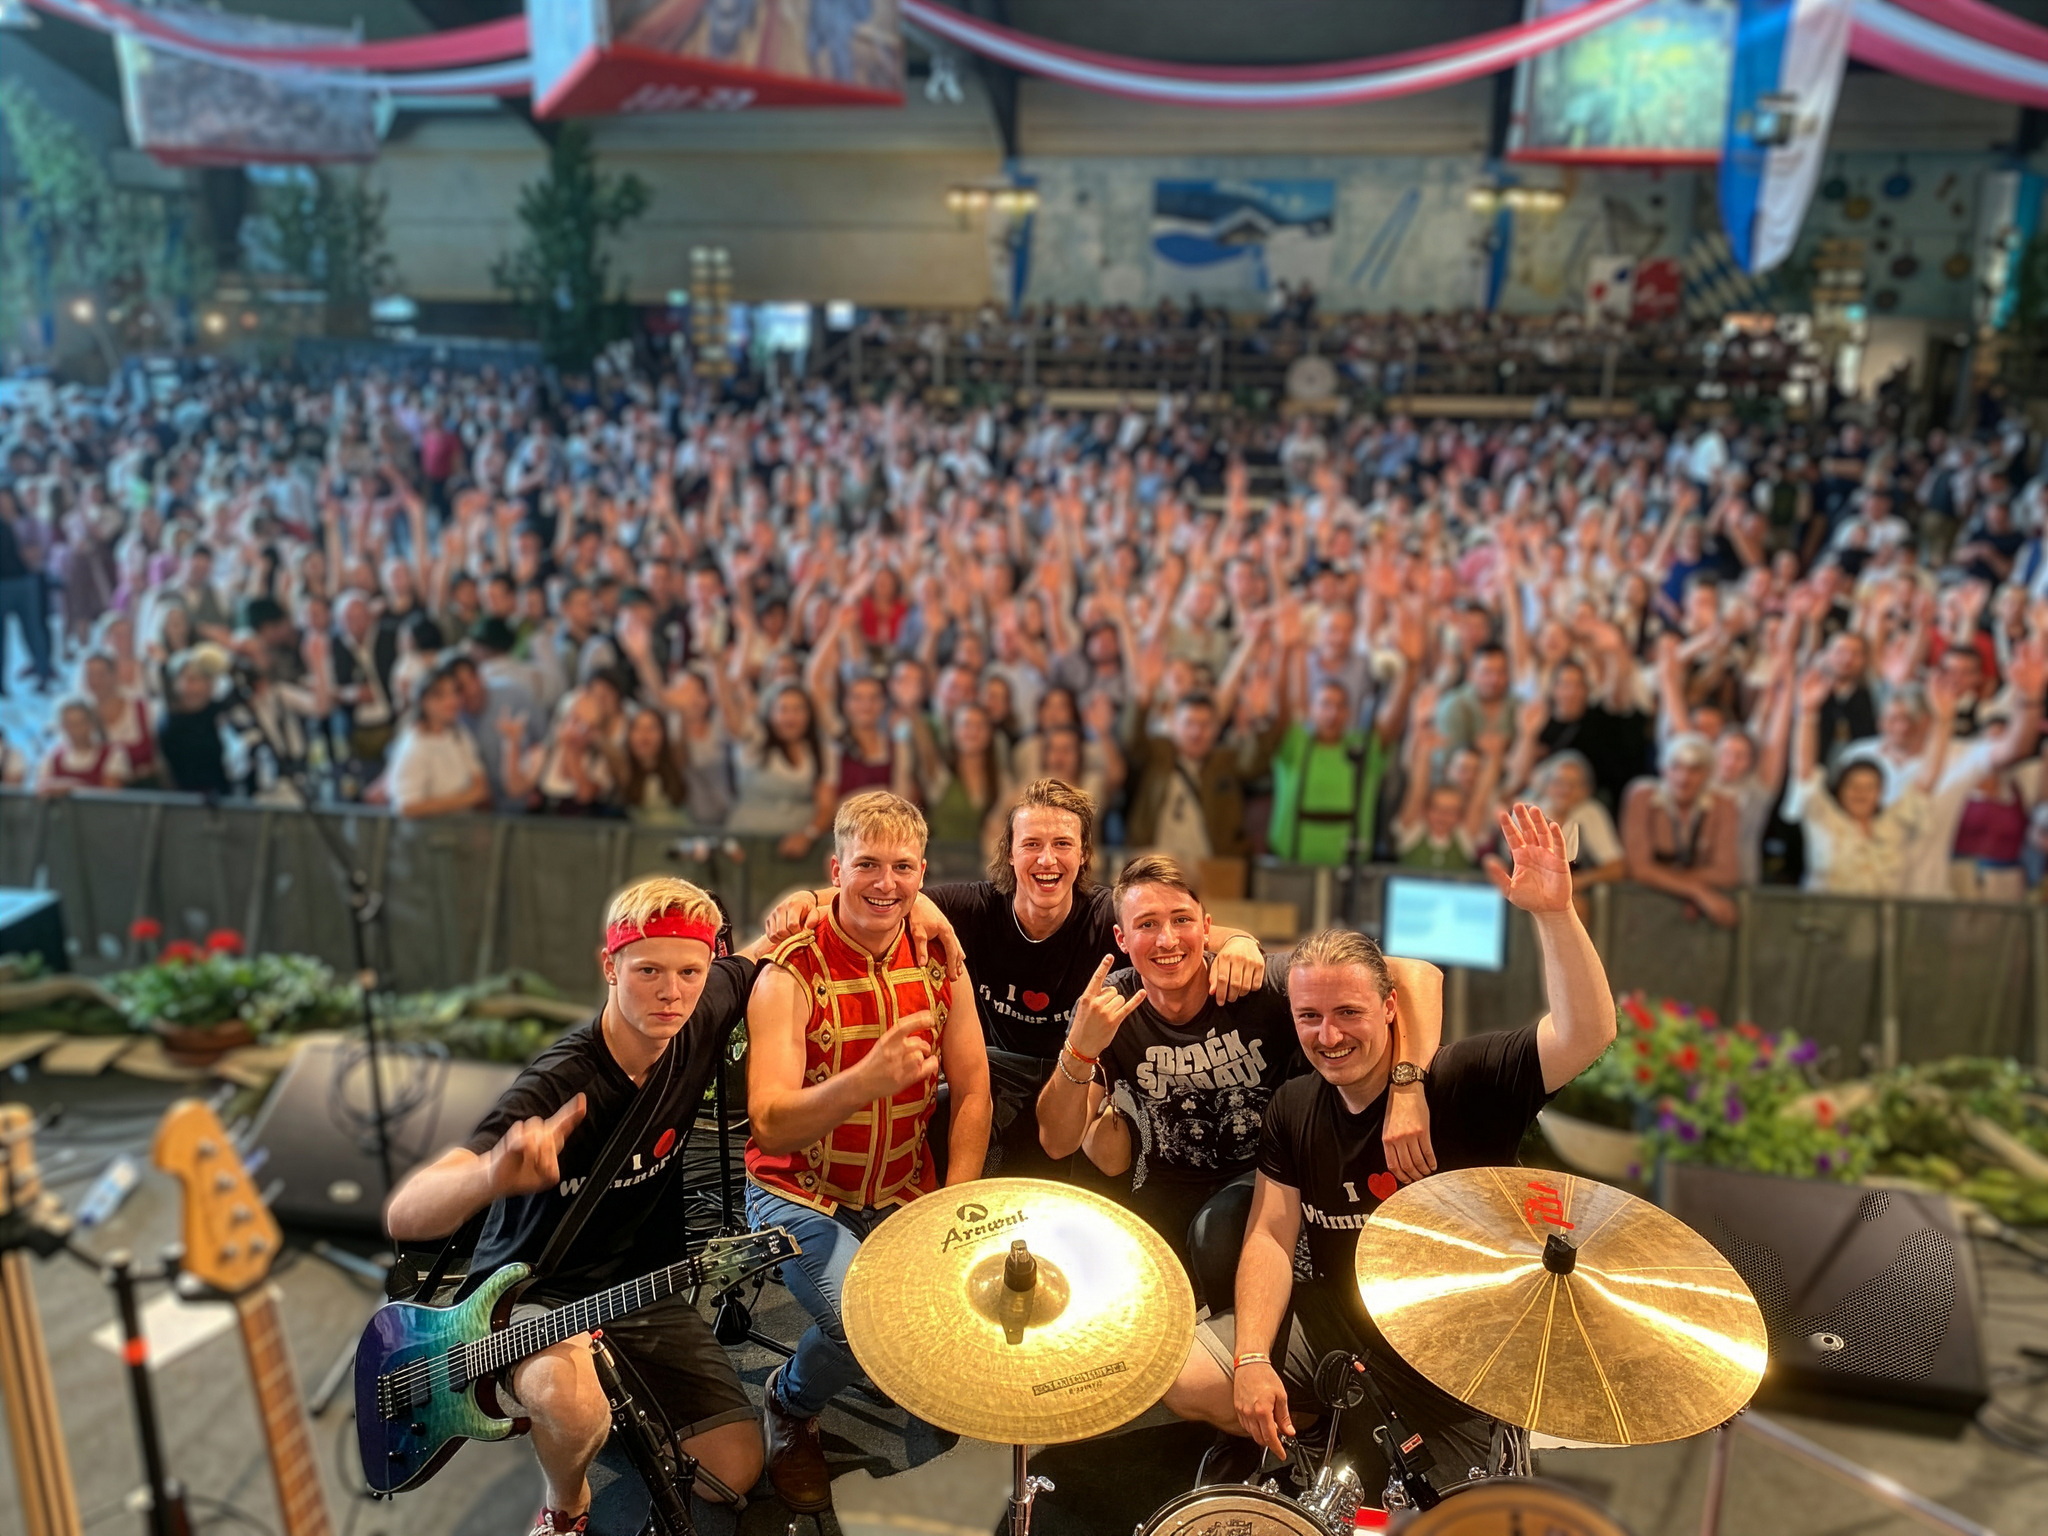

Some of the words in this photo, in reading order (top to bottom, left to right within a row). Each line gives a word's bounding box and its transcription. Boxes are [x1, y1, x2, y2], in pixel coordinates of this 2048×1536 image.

[1006, 983, 1016, 1001] I
[1145, 1027, 1248, 1075] BLACK
[632, 1153, 642, 1170] I
[1343, 1181, 1360, 1202] I
